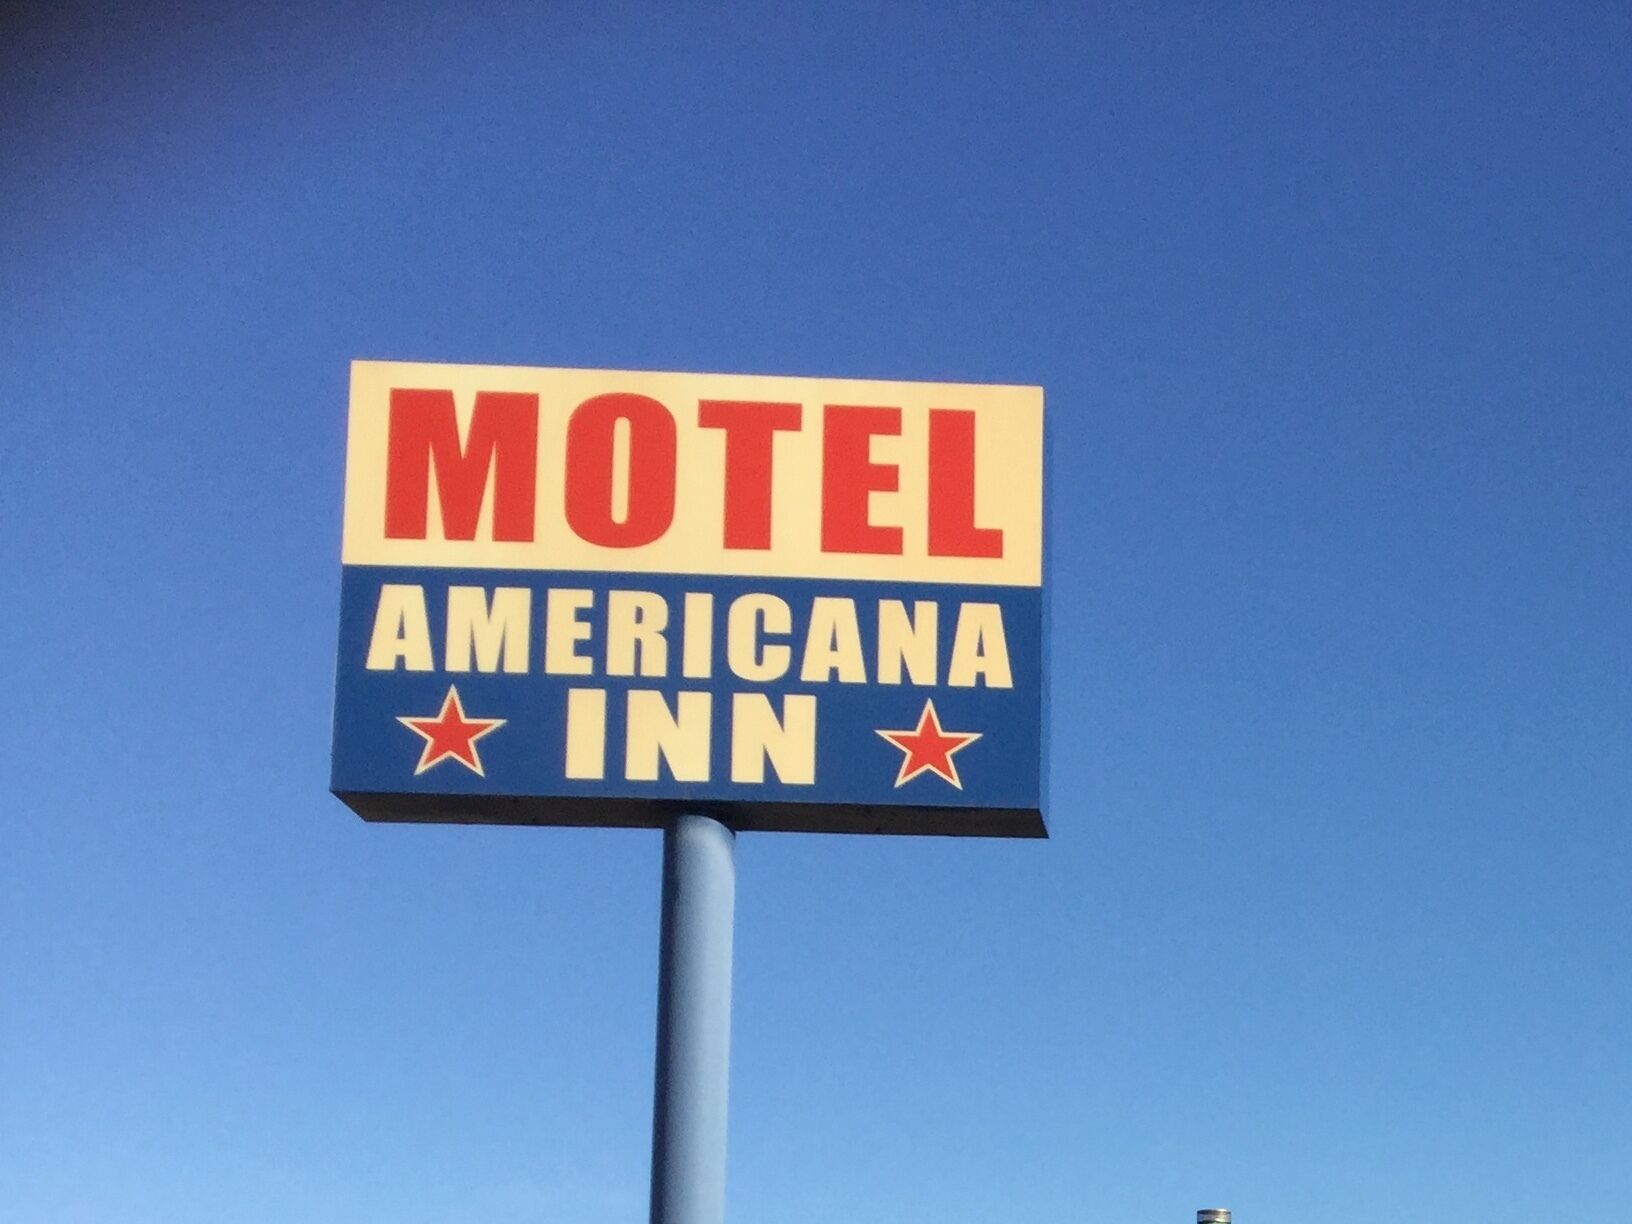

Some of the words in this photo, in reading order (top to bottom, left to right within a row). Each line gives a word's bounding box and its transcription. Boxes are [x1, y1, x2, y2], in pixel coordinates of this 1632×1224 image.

[384, 388, 1003, 558] MOTEL
[366, 585, 1013, 689] AMERICANA
[565, 689, 817, 785] INN
